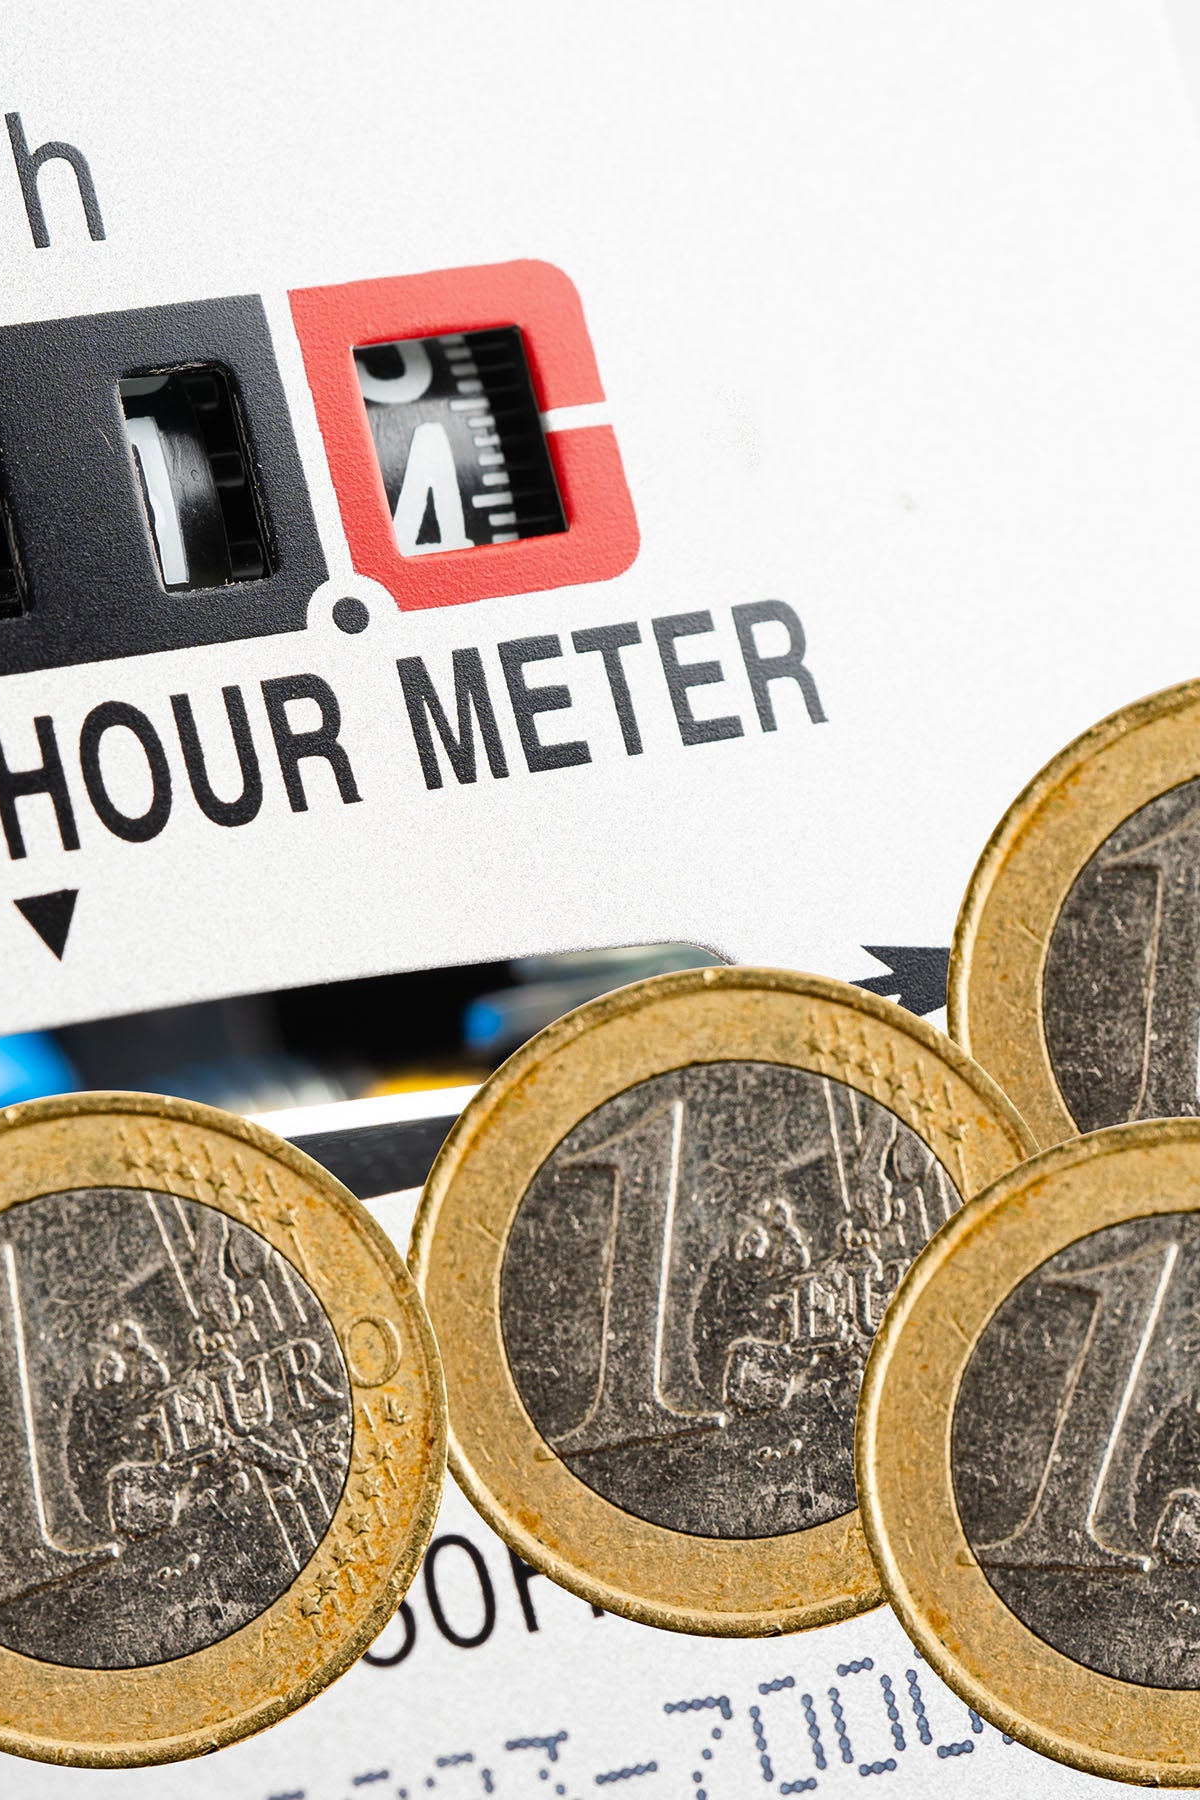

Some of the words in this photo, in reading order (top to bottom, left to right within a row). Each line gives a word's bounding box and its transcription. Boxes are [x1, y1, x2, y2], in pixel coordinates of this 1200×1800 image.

[396, 599, 829, 791] METER
[154, 1314, 402, 1456] EURO
[534, 1100, 730, 1462] 1
[956, 1242, 1178, 1572] 1
